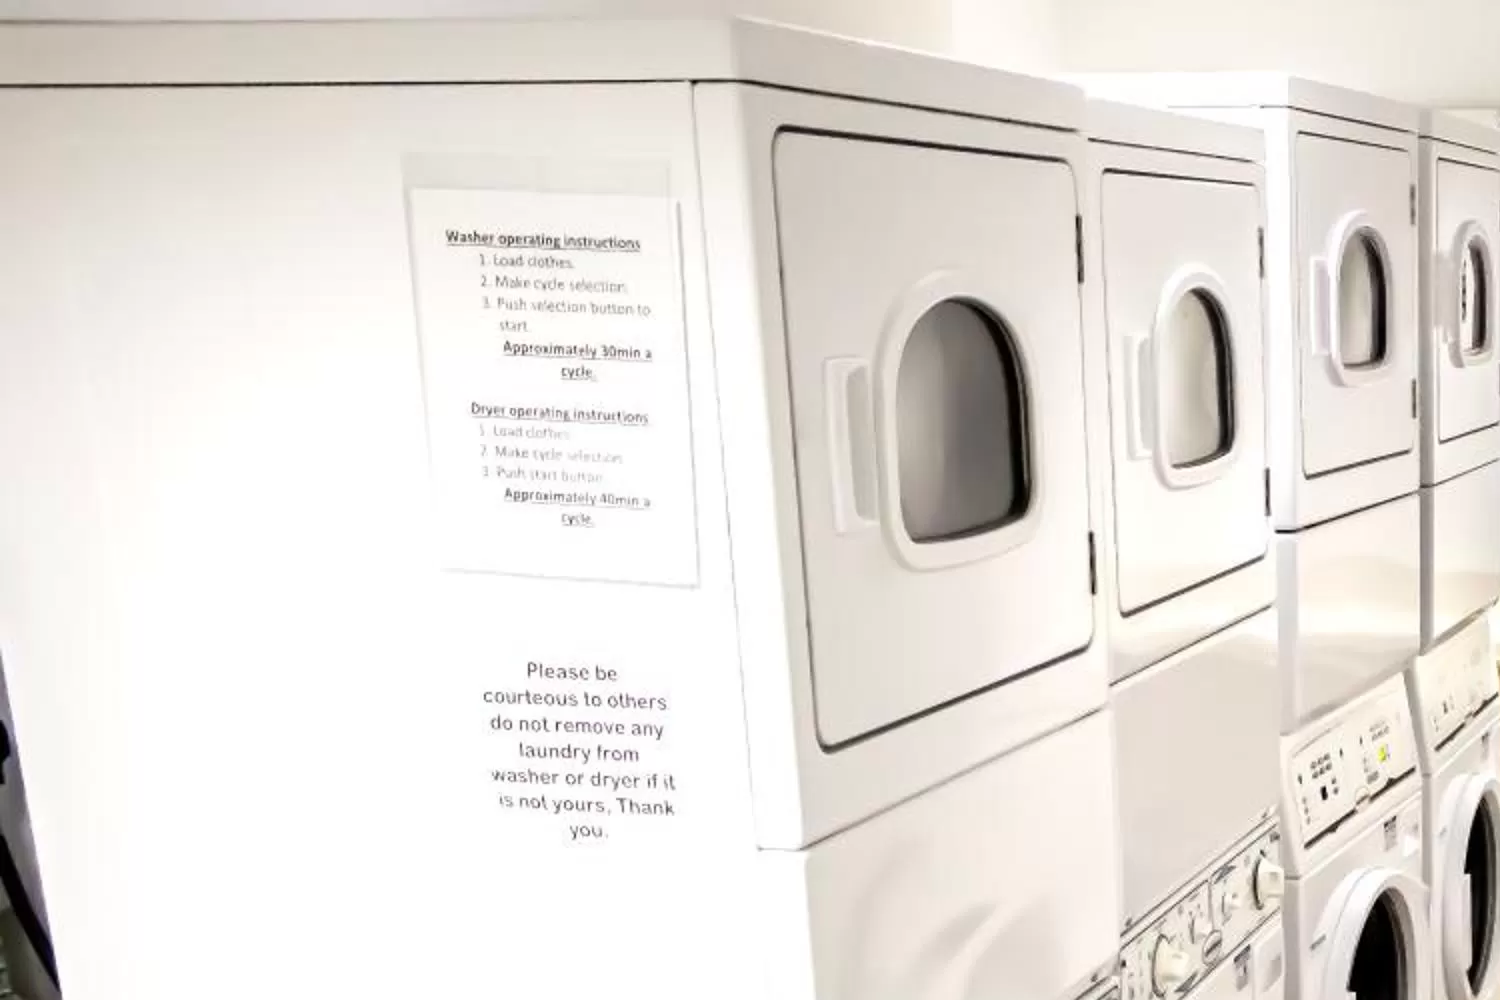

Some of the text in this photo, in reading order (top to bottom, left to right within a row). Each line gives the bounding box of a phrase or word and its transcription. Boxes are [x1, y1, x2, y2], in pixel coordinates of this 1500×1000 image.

[445, 229, 640, 251] Washer operating instructions
[493, 254, 524, 267] Load
[495, 276, 530, 289] Make
[533, 277, 565, 291] cycle
[497, 297, 527, 311] Push
[531, 299, 586, 313] selection
[591, 301, 633, 316] button
[637, 304, 651, 316] to
[503, 340, 597, 359] Approximately
[601, 344, 640, 361] 30min
[471, 402, 649, 425] Dryer operating instructions
[493, 425, 522, 438] Load
[495, 446, 529, 459] Make
[532, 448, 563, 462] cycle
[496, 466, 525, 479] Push
[529, 468, 557, 481] start
[504, 488, 597, 506] Approximately
[599, 493, 639, 509] 40min
[526, 661, 618, 682] Please be
[483, 689, 579, 707] courteous
[583, 691, 602, 708] to
[490, 715, 664, 741] do not remove any
[519, 742, 640, 764] laundry from
[491, 769, 676, 791] washer or dryer if it
[499, 793, 675, 816] is not yours, Thank
[569, 824, 609, 841] you.
